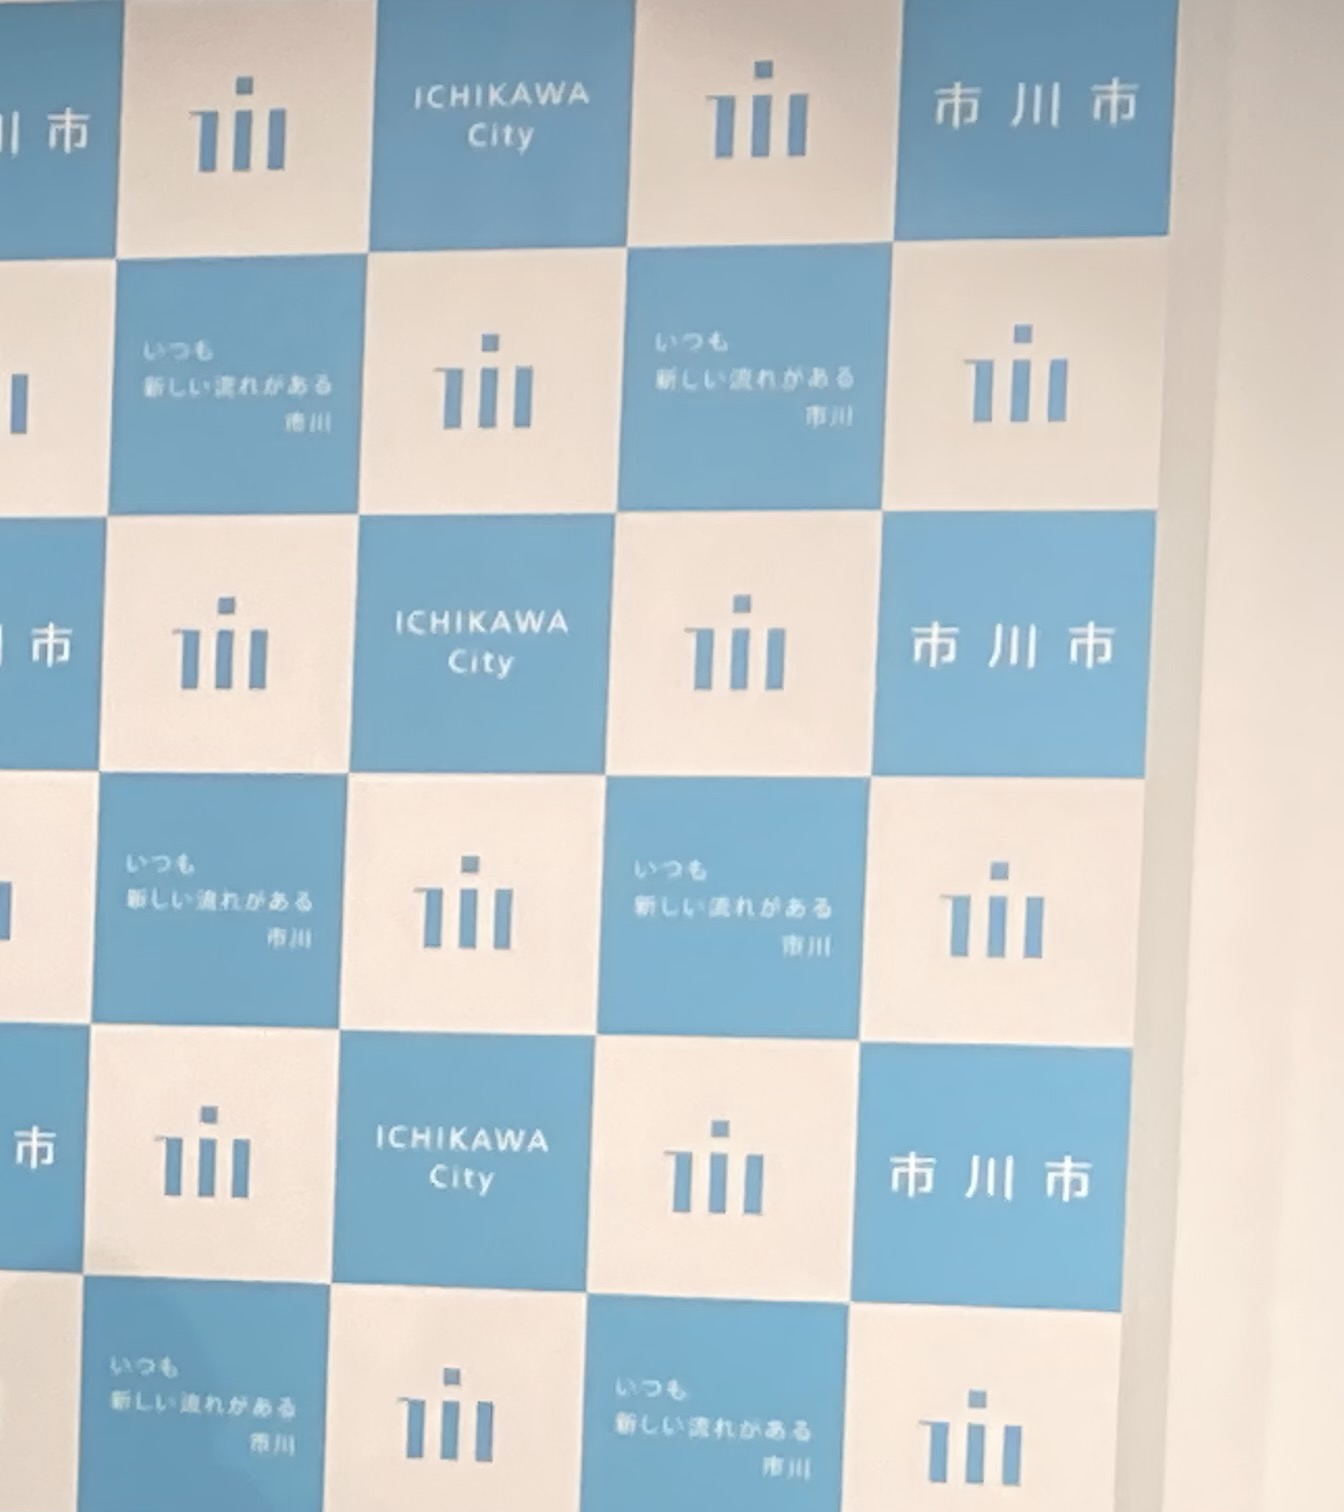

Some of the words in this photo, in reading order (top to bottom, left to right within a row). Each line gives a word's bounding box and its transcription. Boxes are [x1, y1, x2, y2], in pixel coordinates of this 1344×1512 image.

[415, 82, 589, 109] ICHIKAWA
[936, 77, 1136, 129] 市川市
[469, 122, 534, 154] City
[144, 340, 213, 361] いつも
[656, 331, 728, 351] いつも
[144, 374, 331, 398] 新しい流れがある
[656, 367, 853, 390] 新しい流れがある
[286, 412, 330, 432] 市川
[806, 405, 853, 427] 市川
[397, 609, 568, 635] ICHIKAWA
[912, 621, 1114, 669] 市川市
[448, 649, 514, 679] City
[126, 853, 195, 875] いつも
[635, 860, 707, 881] いつも
[127, 888, 312, 912] 新しい流れがある
[635, 895, 832, 919] 新しい流れがある
[267, 927, 311, 948] 市川
[782, 934, 830, 957] 市川
[377, 1125, 548, 1153] ICHIKAWA
[430, 1164, 494, 1196] City
[890, 1152, 1092, 1202] 市川市
[111, 1356, 177, 1378] いつも
[616, 1379, 687, 1402] いつも
[110, 1390, 297, 1418] 新しい流れがある
[615, 1412, 811, 1442] 新しい流れがある
[250, 1433, 295, 1456] 市川
[763, 1455, 810, 1480] 市川
